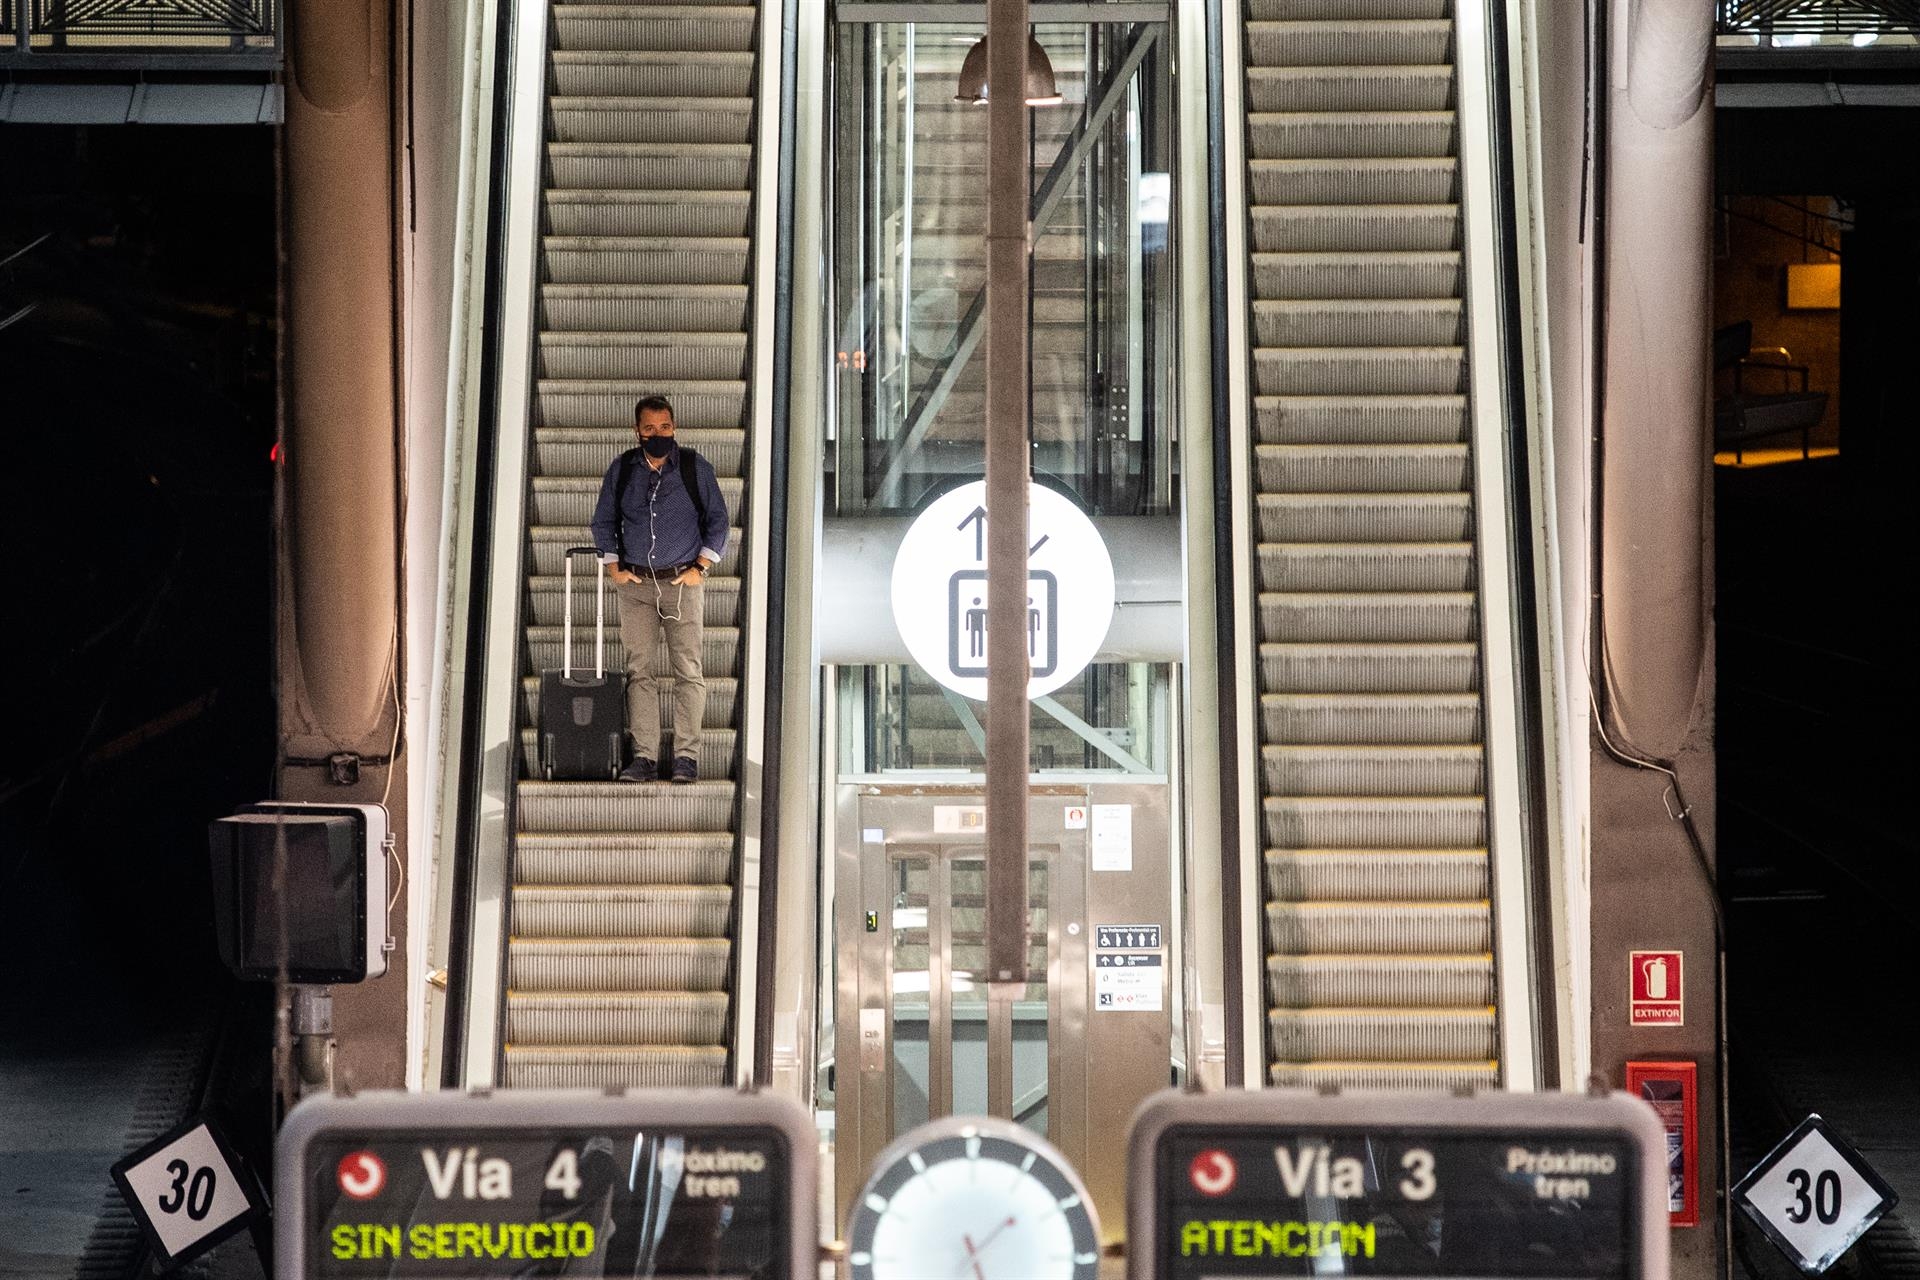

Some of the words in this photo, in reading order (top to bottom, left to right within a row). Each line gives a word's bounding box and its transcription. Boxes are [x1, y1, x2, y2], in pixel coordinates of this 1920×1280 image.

[1634, 1008, 1680, 1018] EXTINTOR
[421, 1147, 512, 1199] Vía
[545, 1149, 582, 1199] 4
[1274, 1146, 1363, 1198] Vía
[1400, 1149, 1436, 1200] 3
[1507, 1146, 1616, 1174] Próximo
[159, 1159, 216, 1221] 30
[685, 1174, 740, 1197] tren
[1535, 1174, 1590, 1199] tren
[1785, 1168, 1842, 1225] 30
[331, 1223, 401, 1259] SIN
[409, 1222, 595, 1259] SERVICIO
[1181, 1220, 1375, 1258] ATENCION
